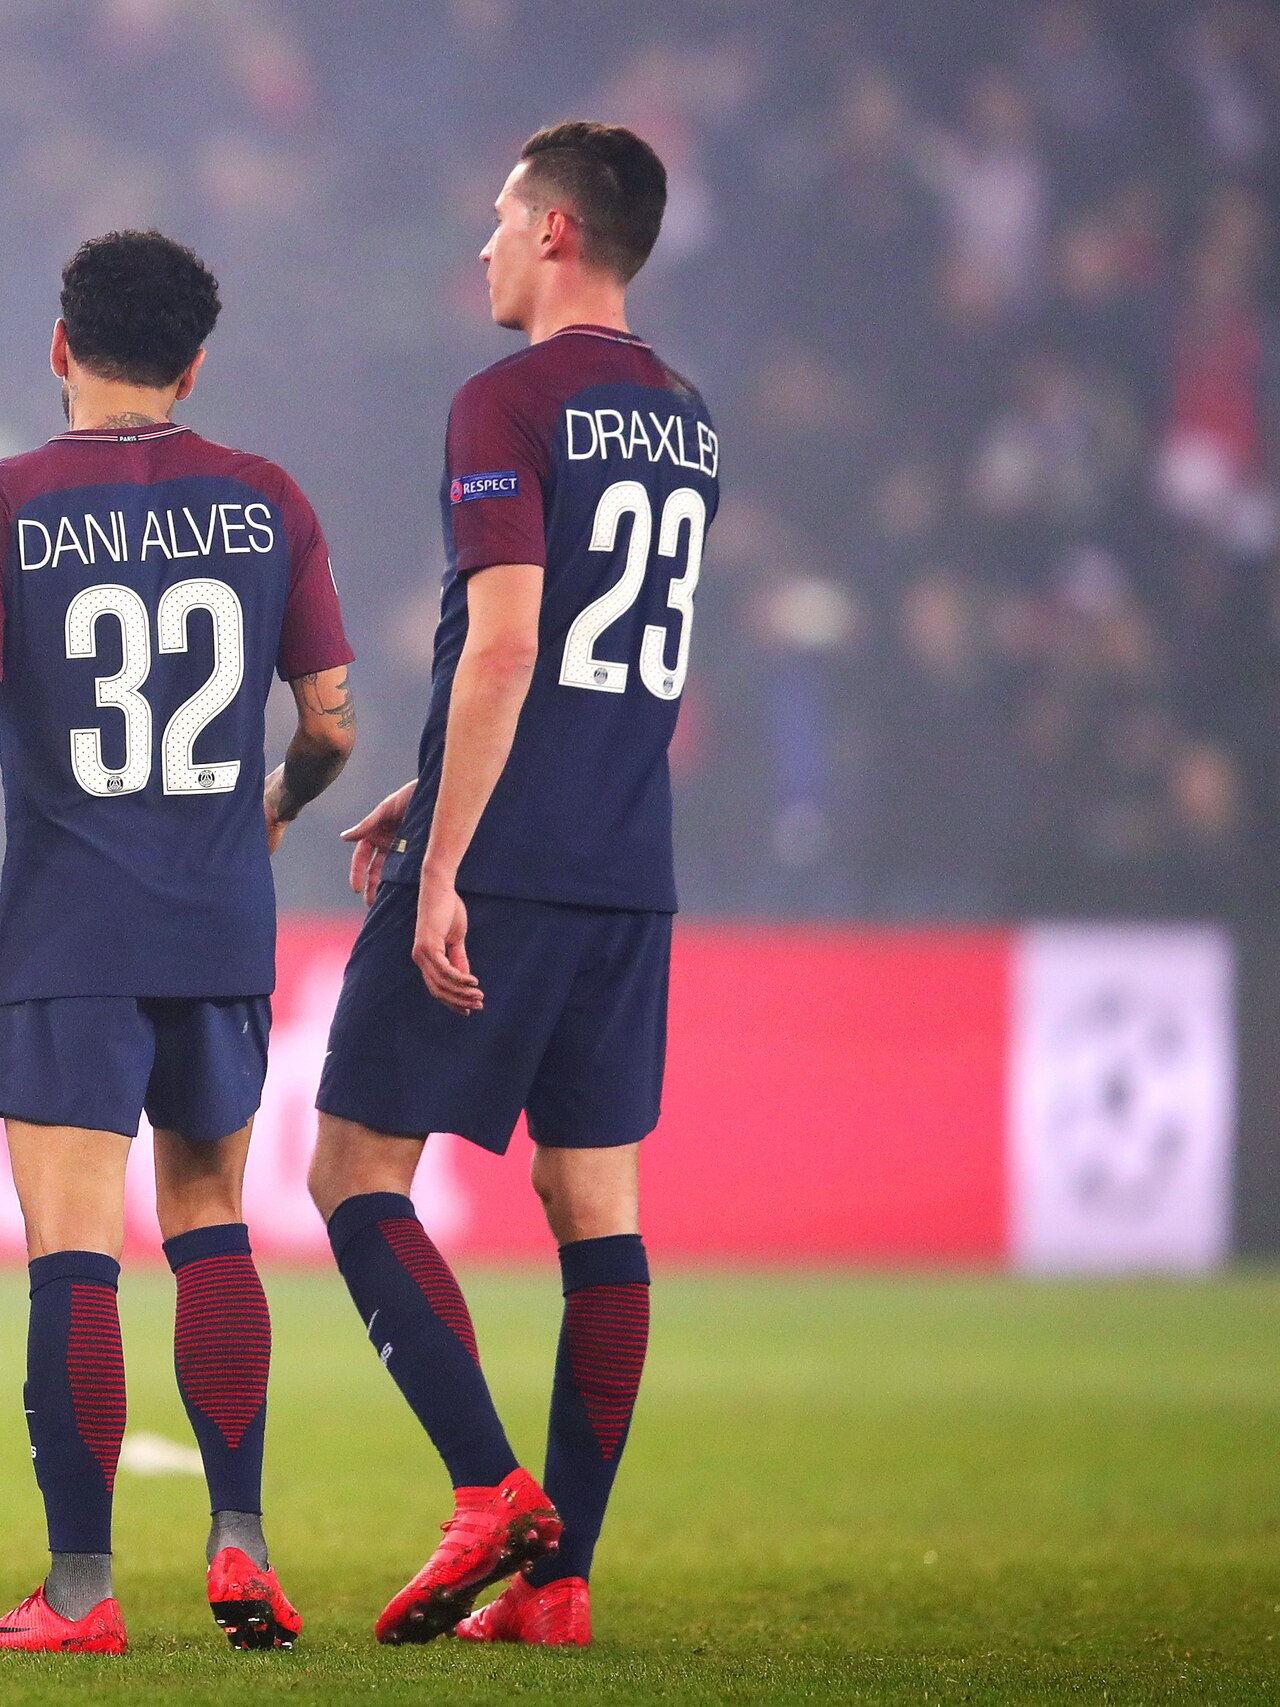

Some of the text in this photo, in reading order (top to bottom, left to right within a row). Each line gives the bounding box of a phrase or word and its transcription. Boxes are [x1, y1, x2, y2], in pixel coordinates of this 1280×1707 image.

[18, 503, 274, 571] DANI ALVES
[463, 478, 517, 494] RESPECT
[559, 481, 706, 700] 23
[64, 577, 245, 797] 32
